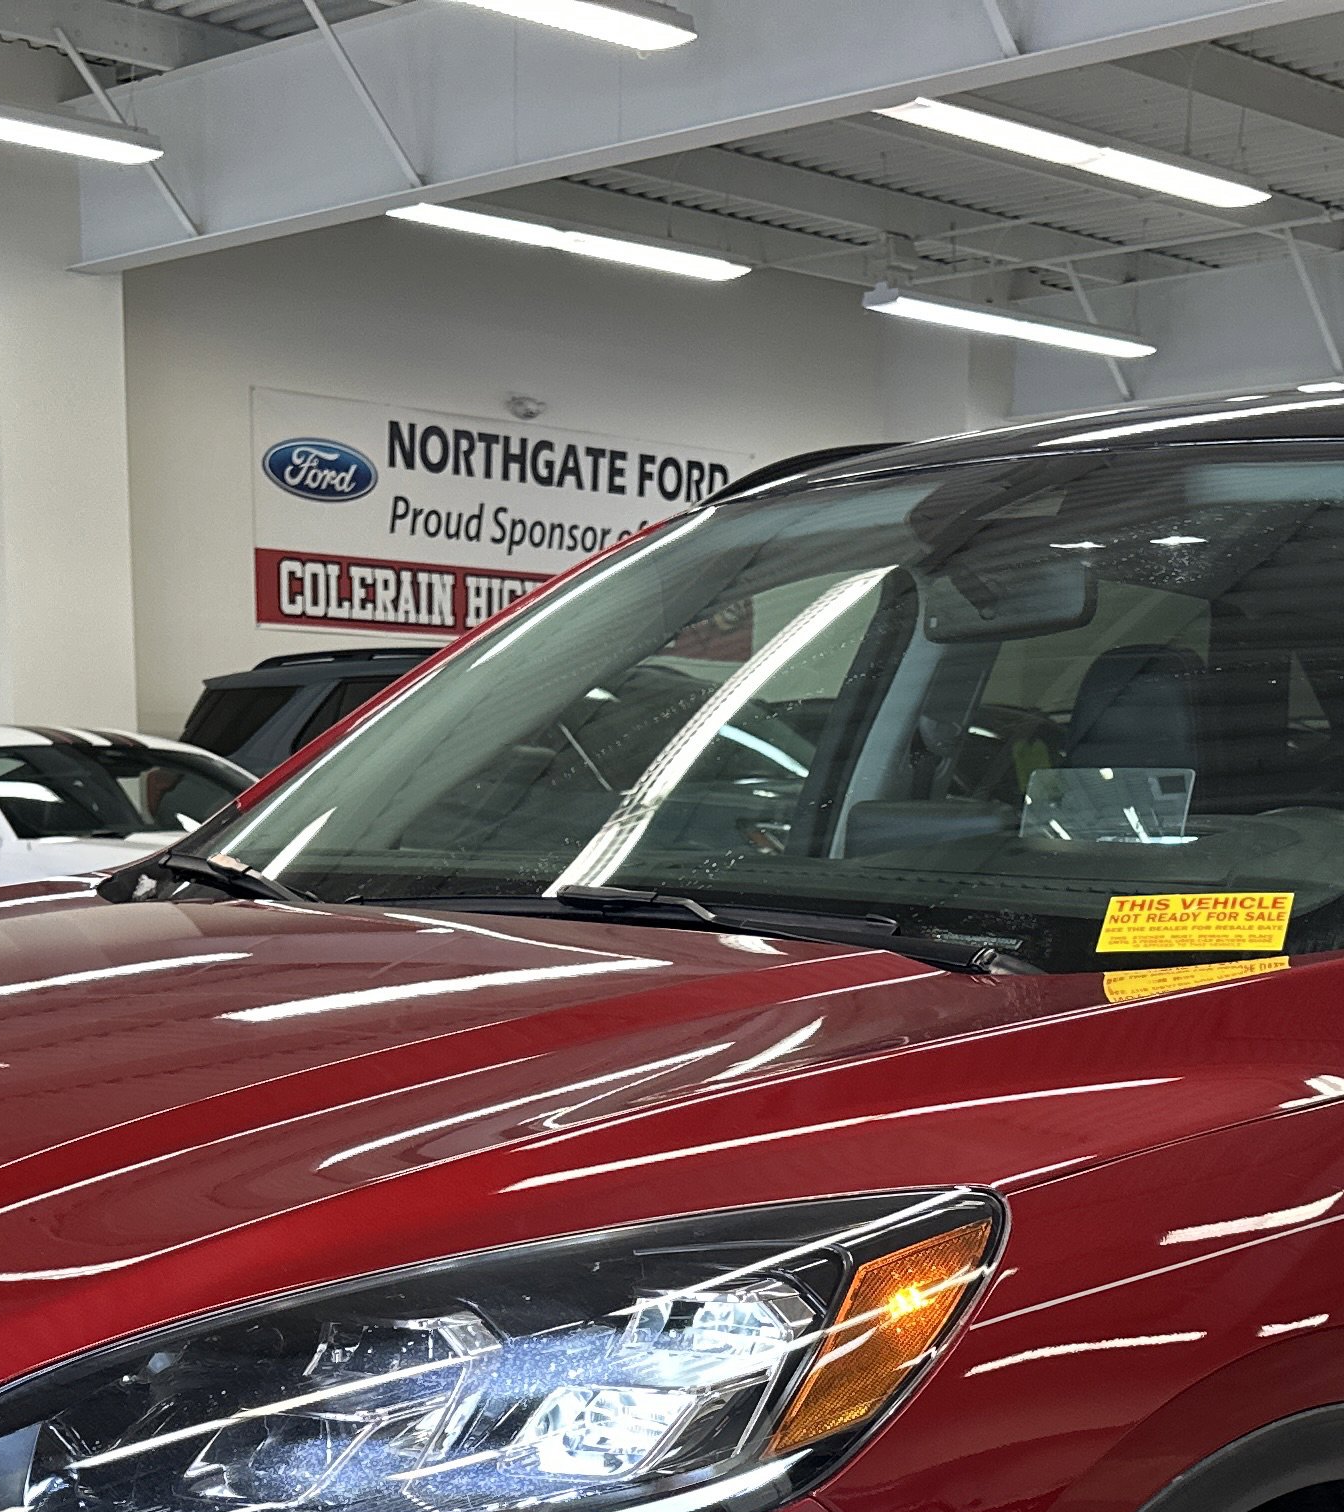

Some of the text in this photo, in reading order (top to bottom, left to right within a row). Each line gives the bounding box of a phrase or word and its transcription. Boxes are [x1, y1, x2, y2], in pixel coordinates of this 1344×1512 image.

[282, 445, 358, 494] Ford
[386, 419, 629, 496] NORTHGATE
[389, 495, 485, 542] Proud
[490, 506, 612, 556] Sponsor
[277, 557, 456, 629] COLERAIN
[1108, 911, 1287, 924] NOT READY FOR SALE
[1115, 896, 1288, 913] THIS VEHICLE
